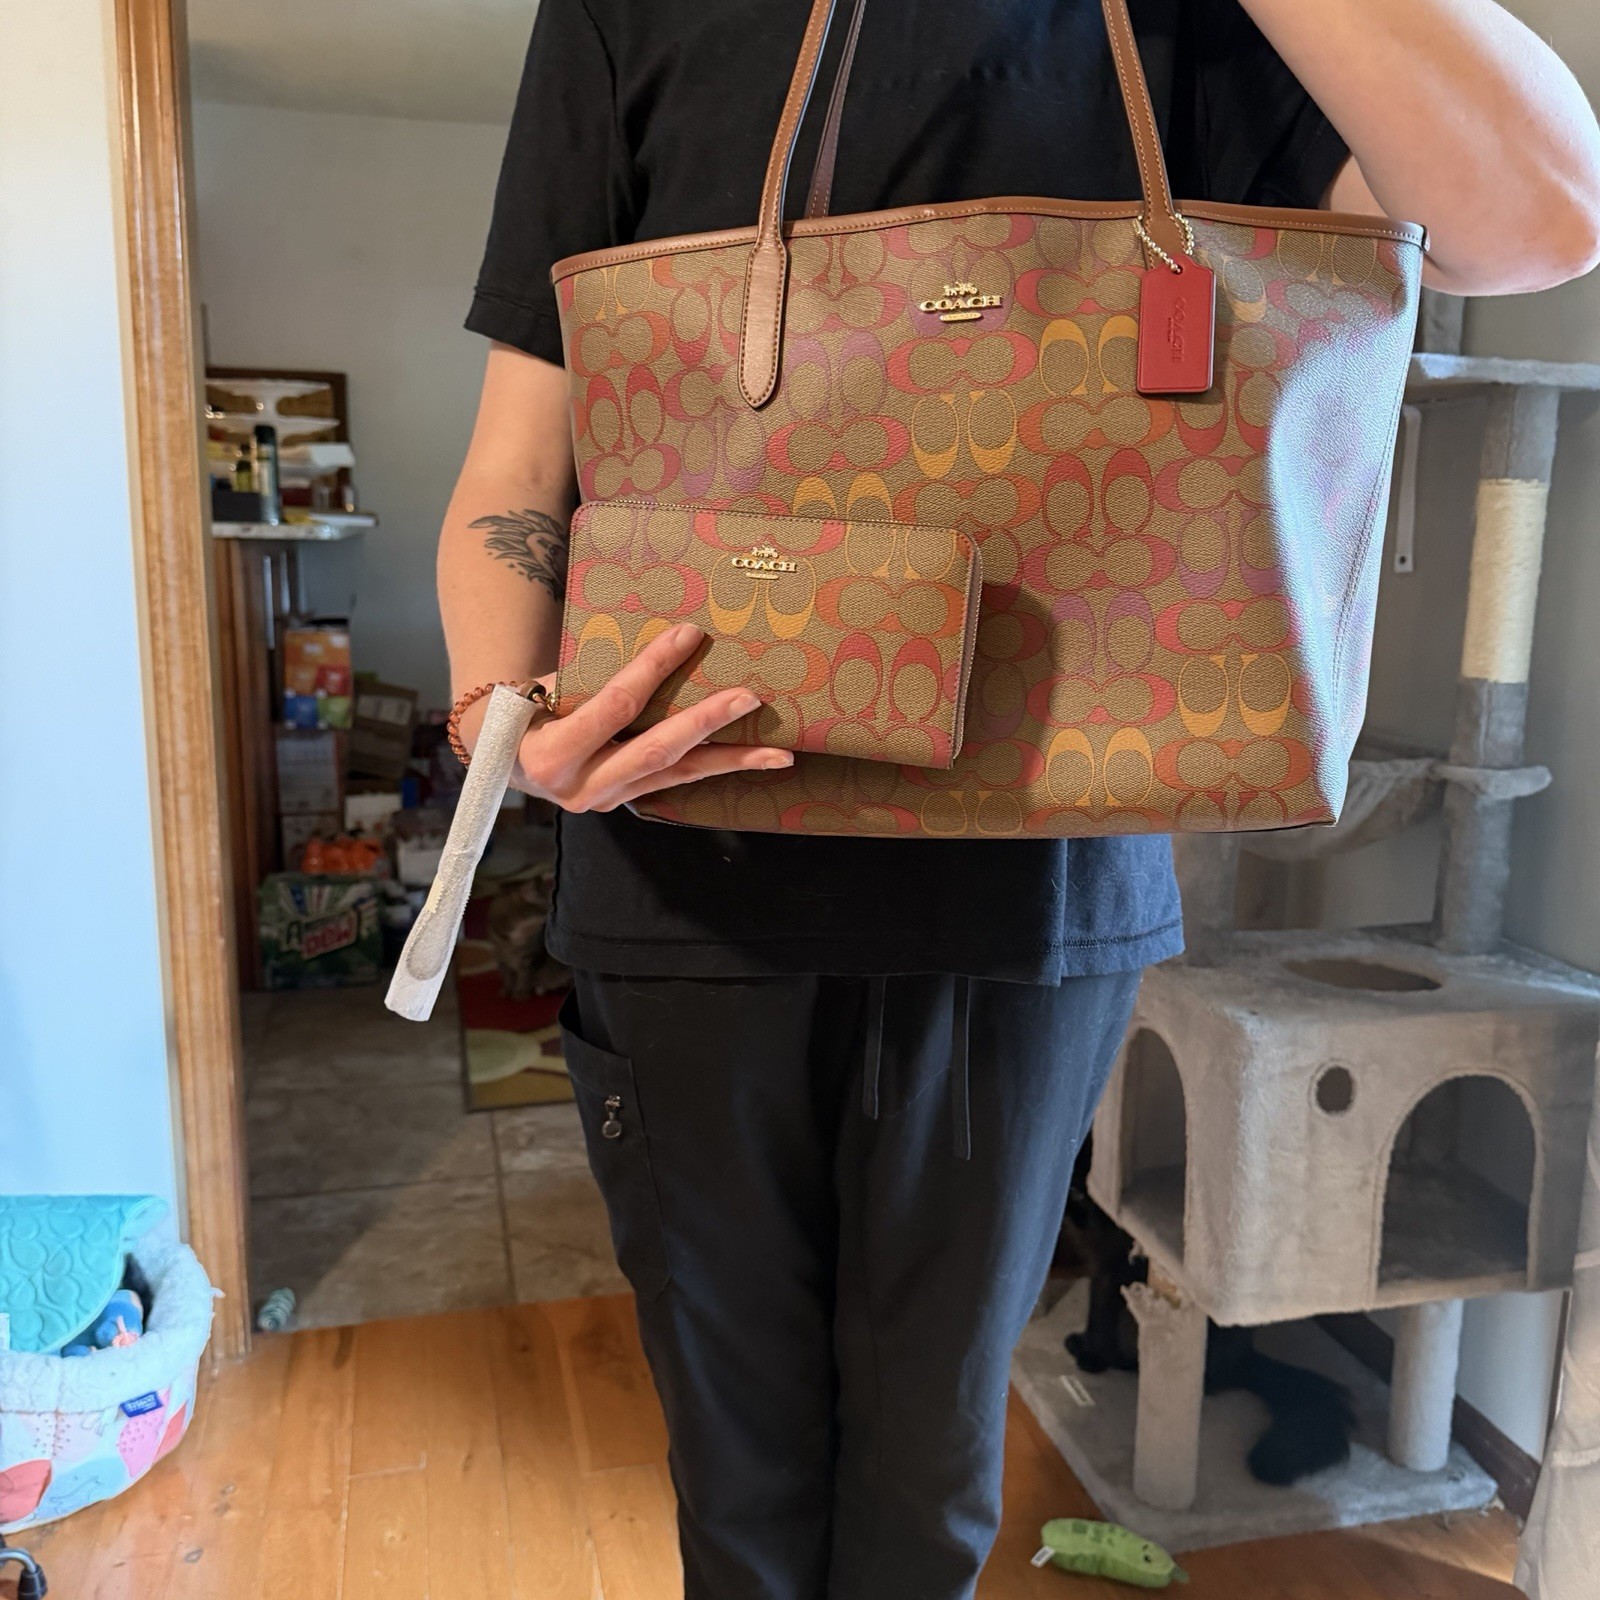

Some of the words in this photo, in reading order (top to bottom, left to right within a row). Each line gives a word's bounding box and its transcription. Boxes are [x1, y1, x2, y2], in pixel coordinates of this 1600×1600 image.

[920, 295, 1003, 312] COACH
[1171, 297, 1187, 363] COACH
[731, 558, 797, 571] COACH
